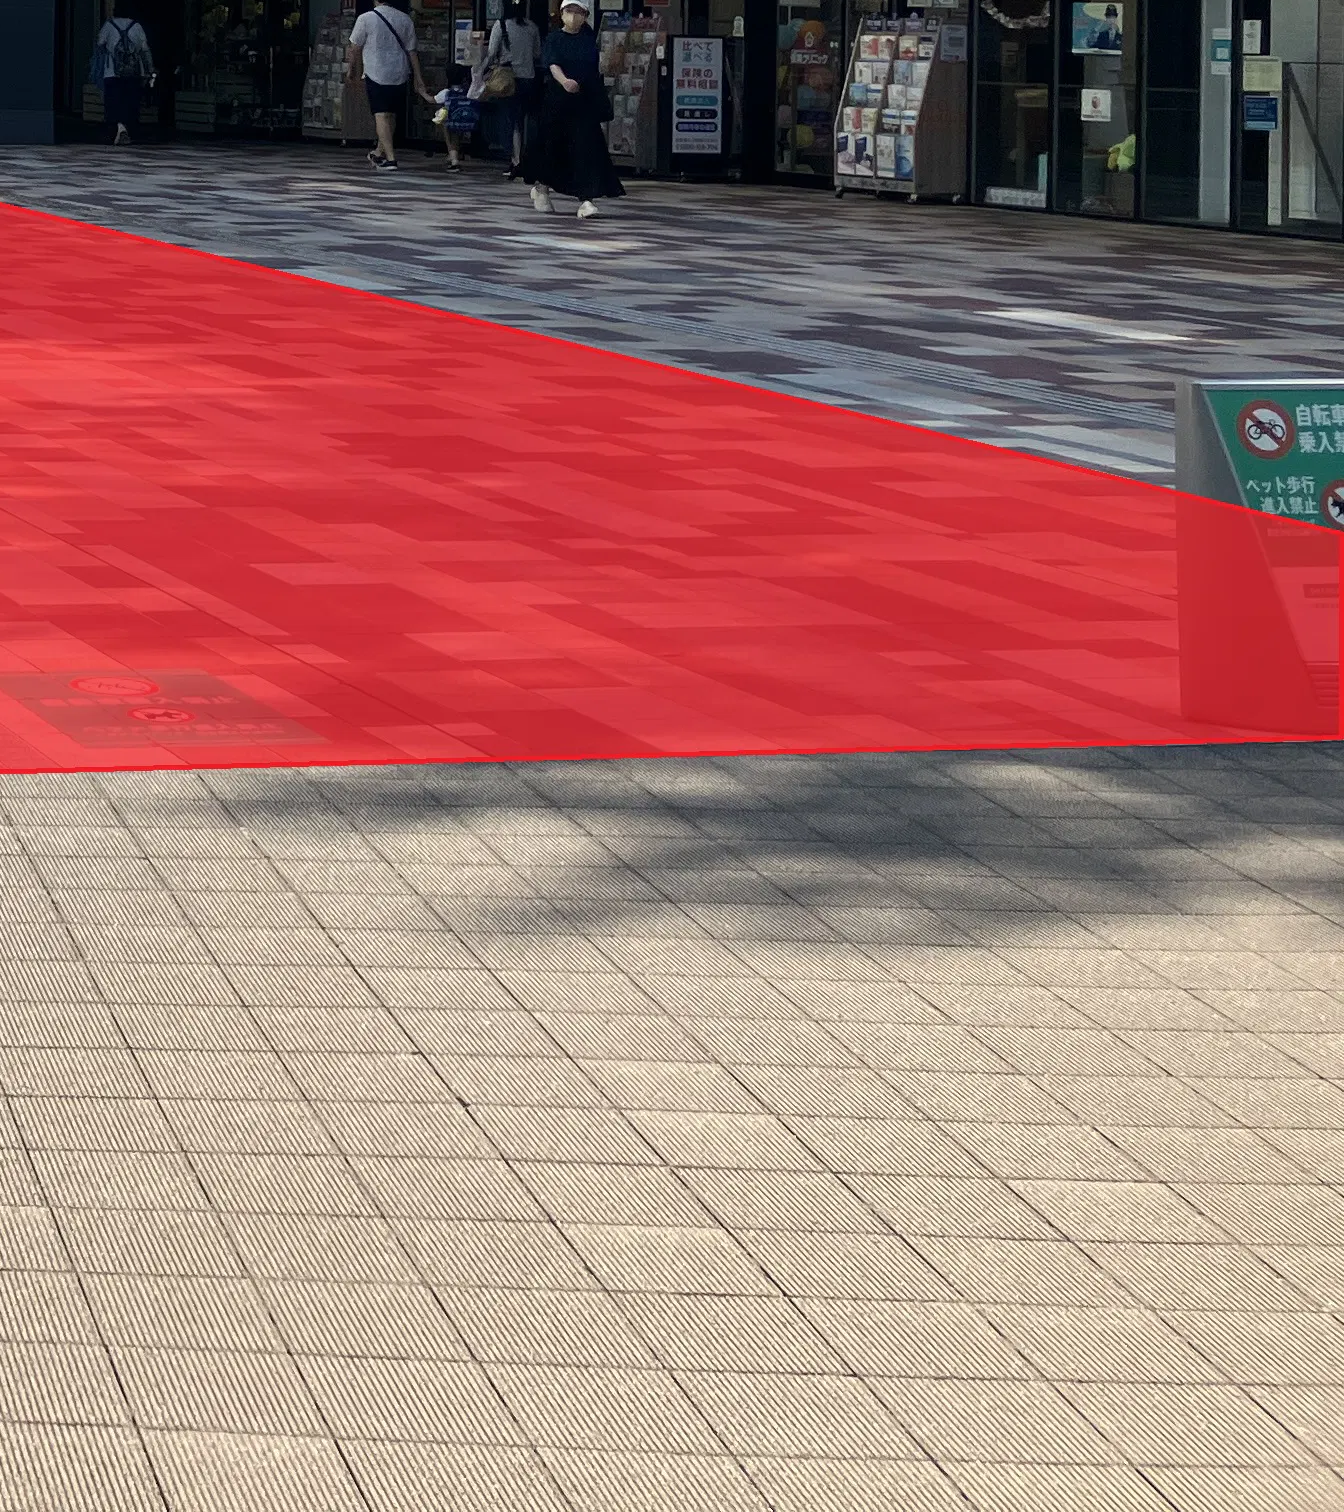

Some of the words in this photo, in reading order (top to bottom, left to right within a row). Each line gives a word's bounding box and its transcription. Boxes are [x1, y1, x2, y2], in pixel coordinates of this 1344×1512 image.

[1246, 476, 1315, 494] ペット歩行
